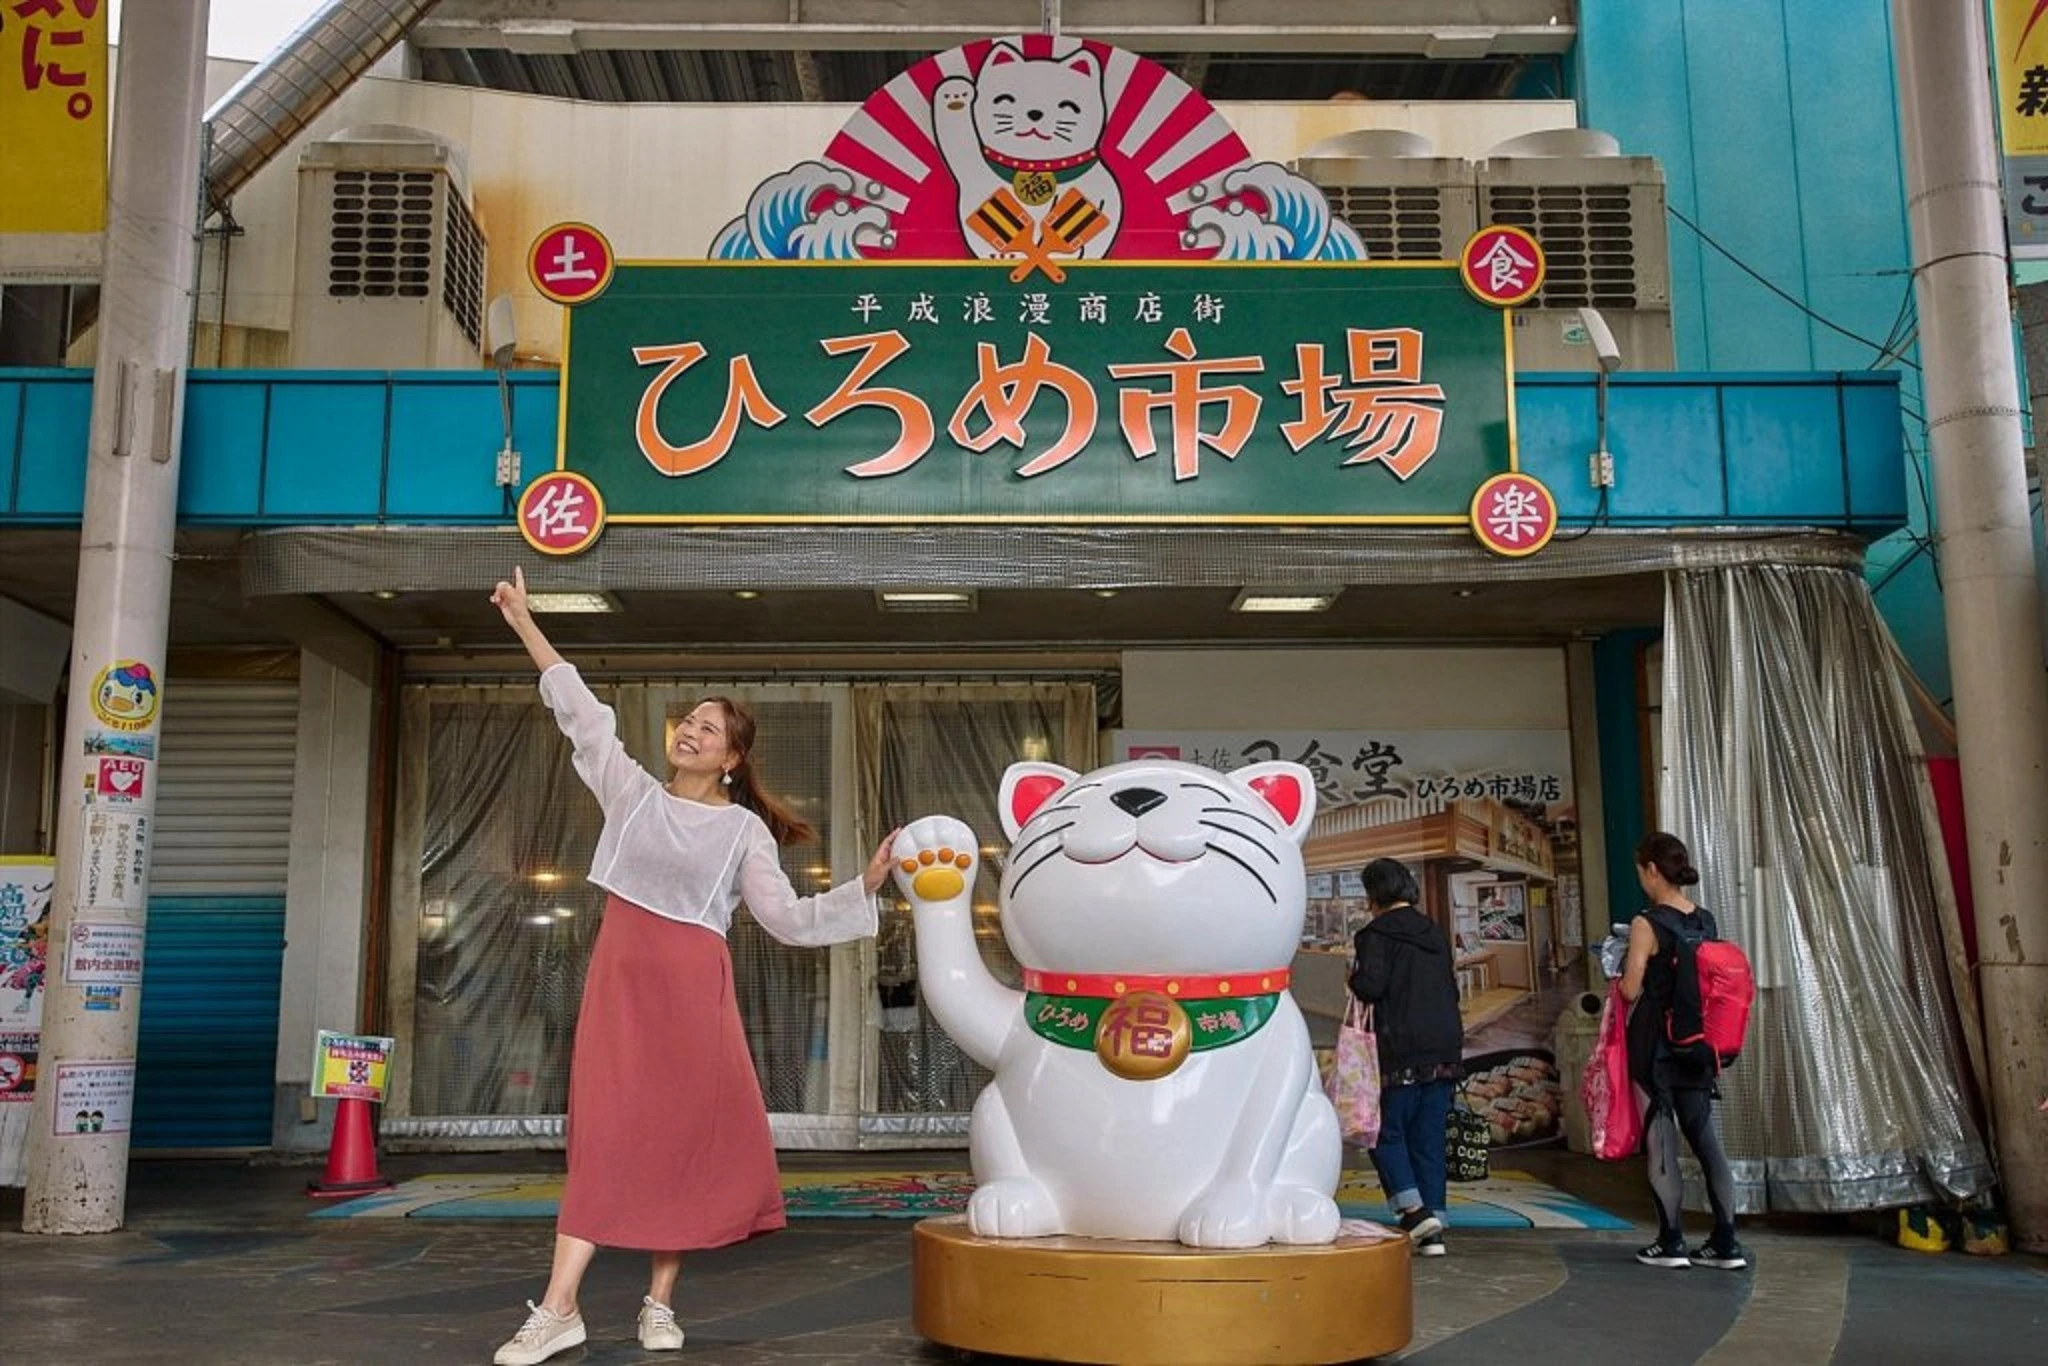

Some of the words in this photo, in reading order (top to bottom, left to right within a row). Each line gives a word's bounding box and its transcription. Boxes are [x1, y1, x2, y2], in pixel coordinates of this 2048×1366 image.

[543, 235, 597, 282] 土
[1474, 235, 1535, 292] 食
[850, 292, 1226, 325] 平成浪漫商店街
[631, 327, 1446, 482] ひろめ市場
[527, 482, 589, 538] 佐
[1486, 483, 1544, 542] 楽
[103, 759, 142, 773] AED
[1241, 738, 1408, 802] 食堂
[1416, 775, 1562, 801] ひろめ市場店
[1037, 1003, 1090, 1033] ひろめ
[1101, 997, 1173, 1059] 福
